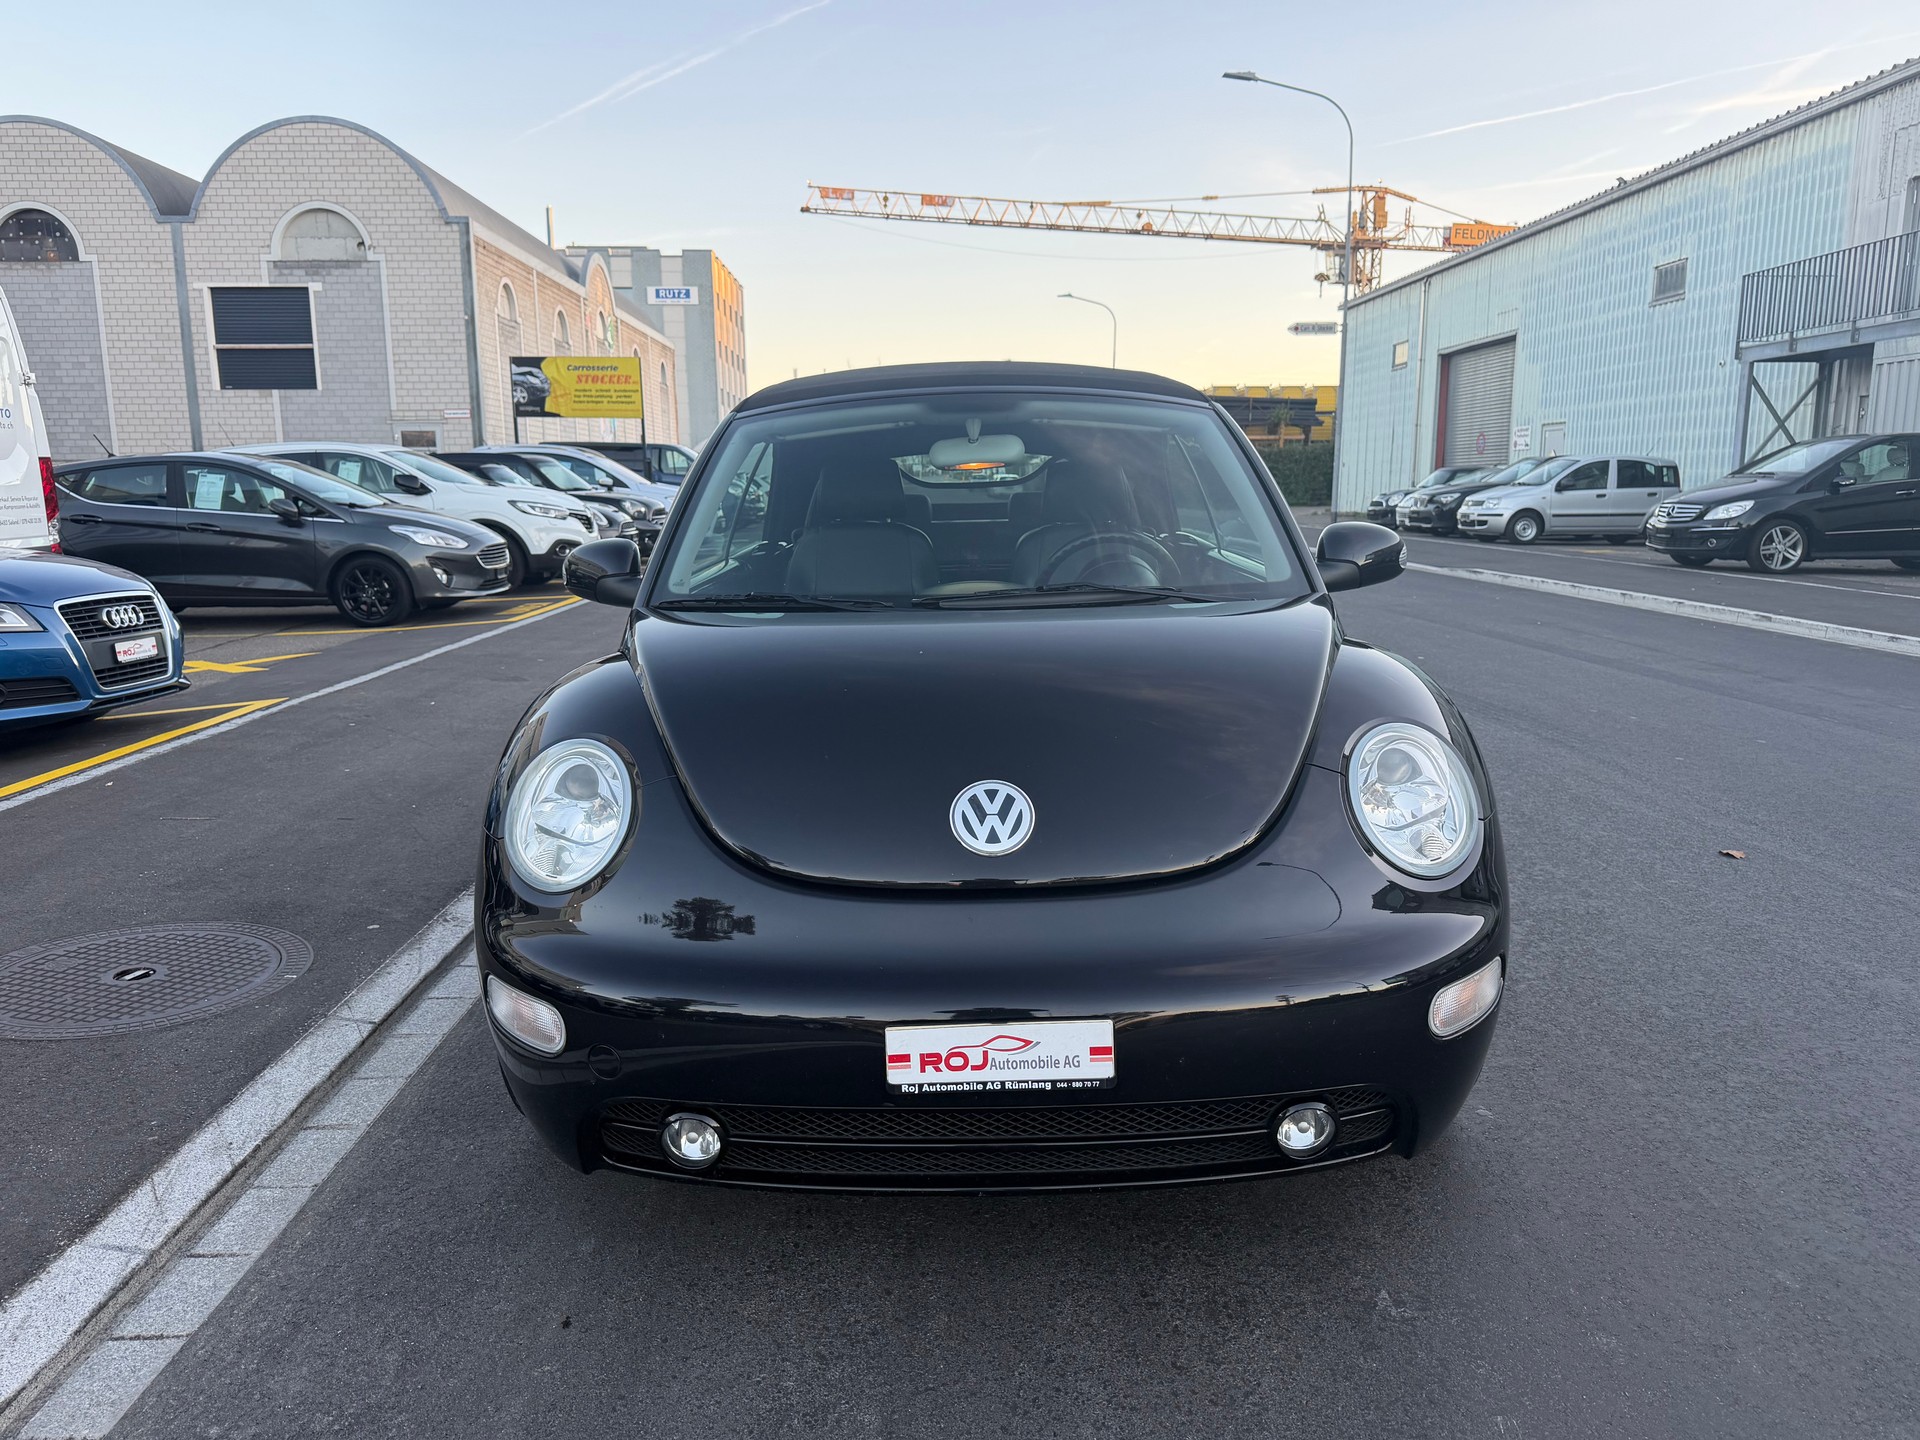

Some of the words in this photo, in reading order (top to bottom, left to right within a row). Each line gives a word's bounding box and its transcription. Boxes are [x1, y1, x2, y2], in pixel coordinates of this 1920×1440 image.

[1455, 228, 1507, 242] FELDMA
[660, 289, 686, 298] RUTZ
[577, 374, 632, 384] STOCKER
[955, 784, 1030, 850] VW
[919, 1050, 989, 1073] ROJ
[989, 1055, 1061, 1071] Automobile
[1063, 1055, 1081, 1068] AG
[901, 1084, 919, 1093] Roj
[922, 1082, 984, 1092] Automobile
[986, 1081, 1002, 1090] AG
[1005, 1080, 1052, 1090] Rümlang
